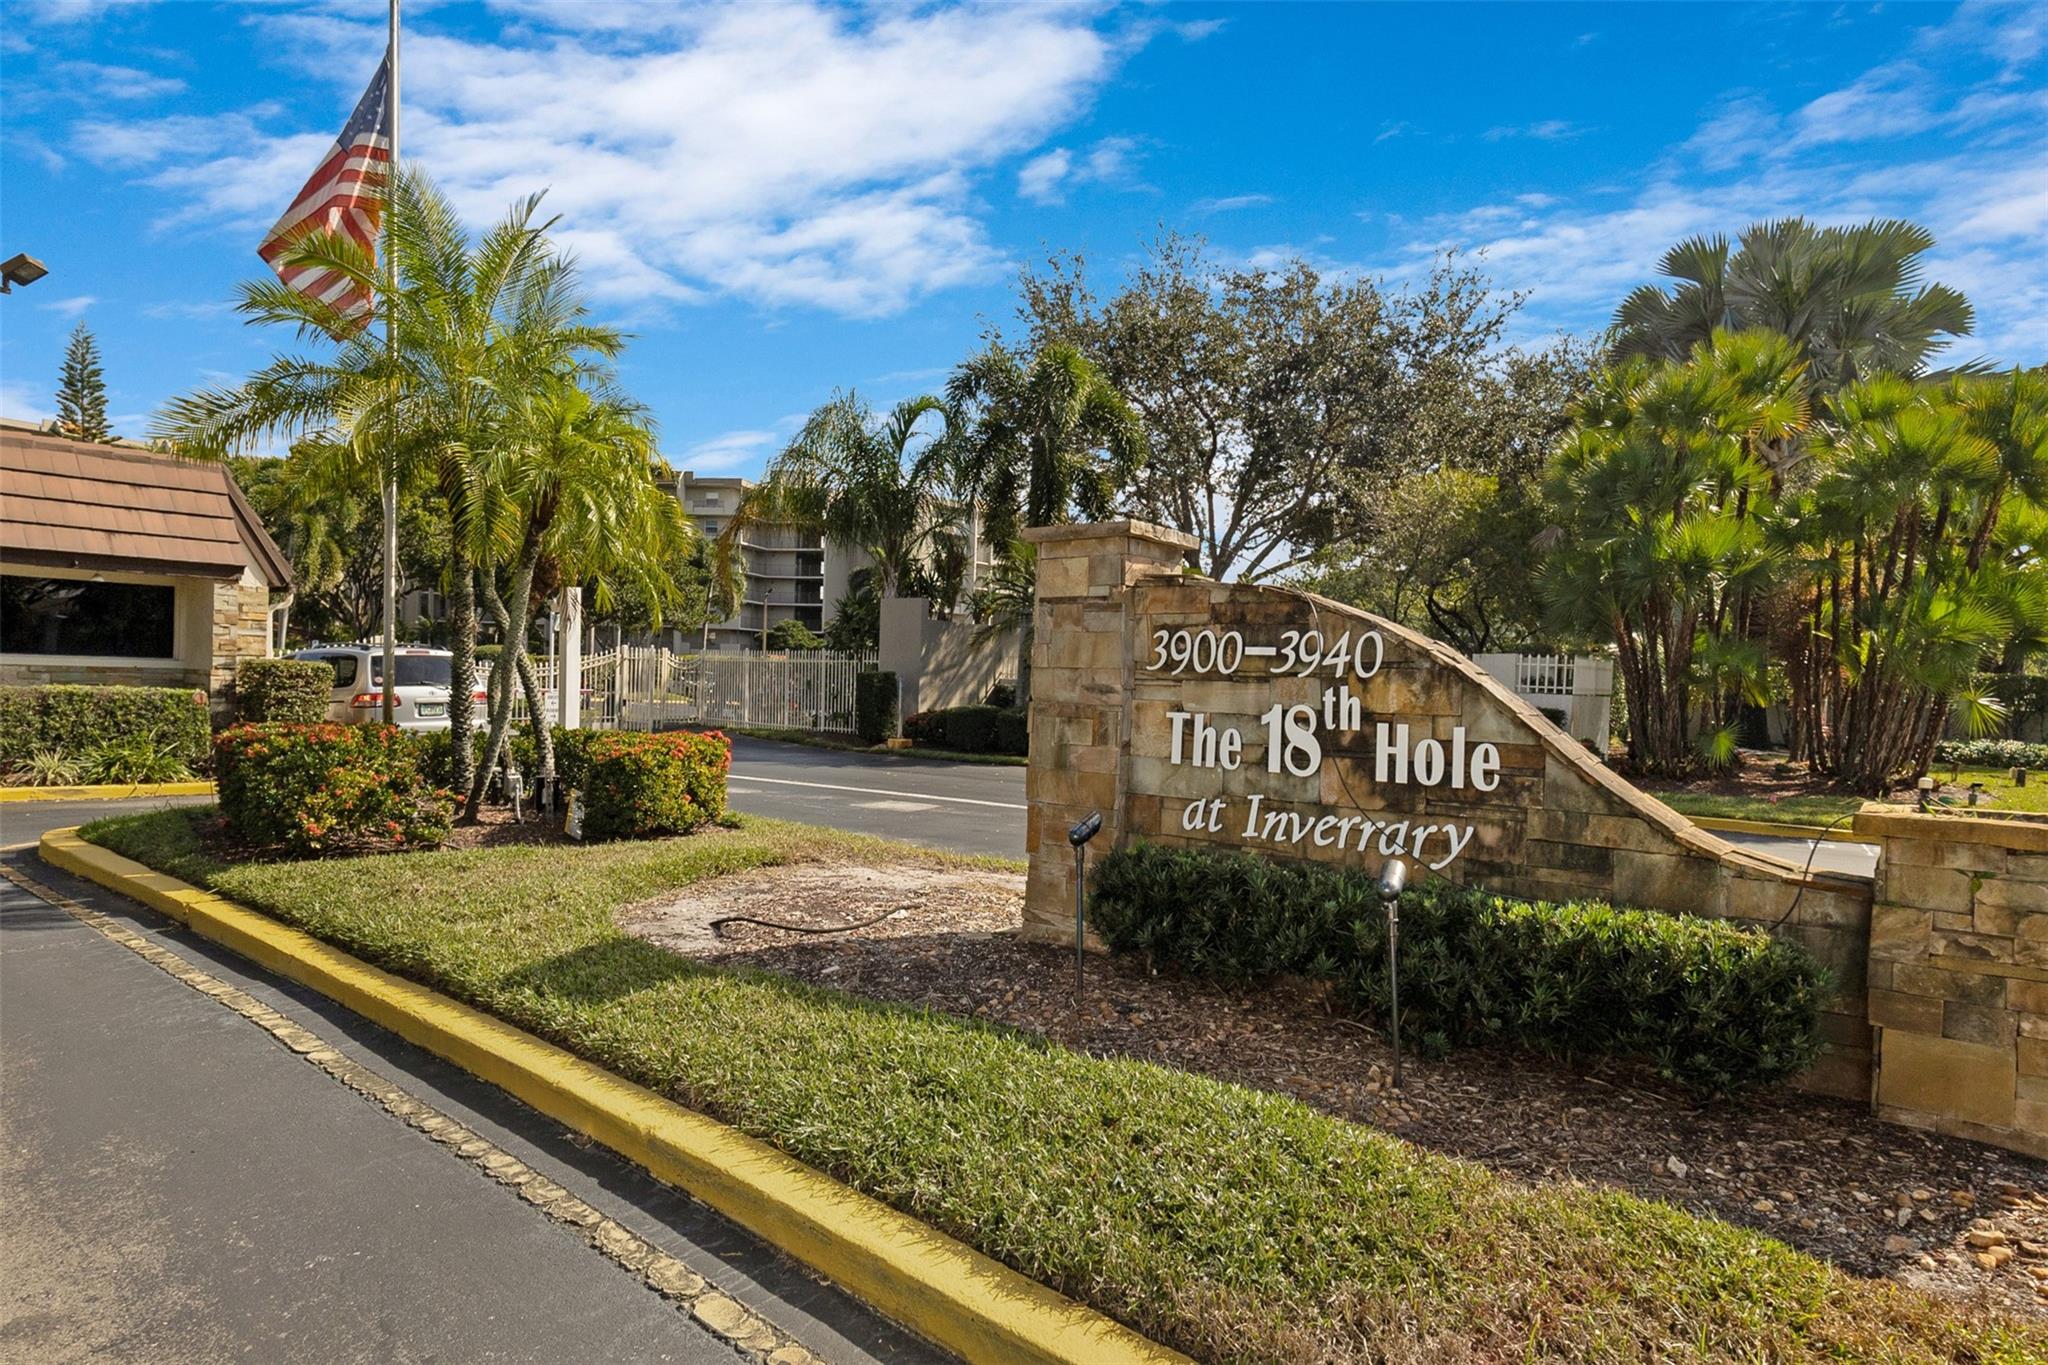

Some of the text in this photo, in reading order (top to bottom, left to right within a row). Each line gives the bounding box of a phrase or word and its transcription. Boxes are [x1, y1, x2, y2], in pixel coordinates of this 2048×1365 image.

[1166, 685, 1500, 792] The 18th Hole
[1182, 794, 1474, 870] at Inverrary
